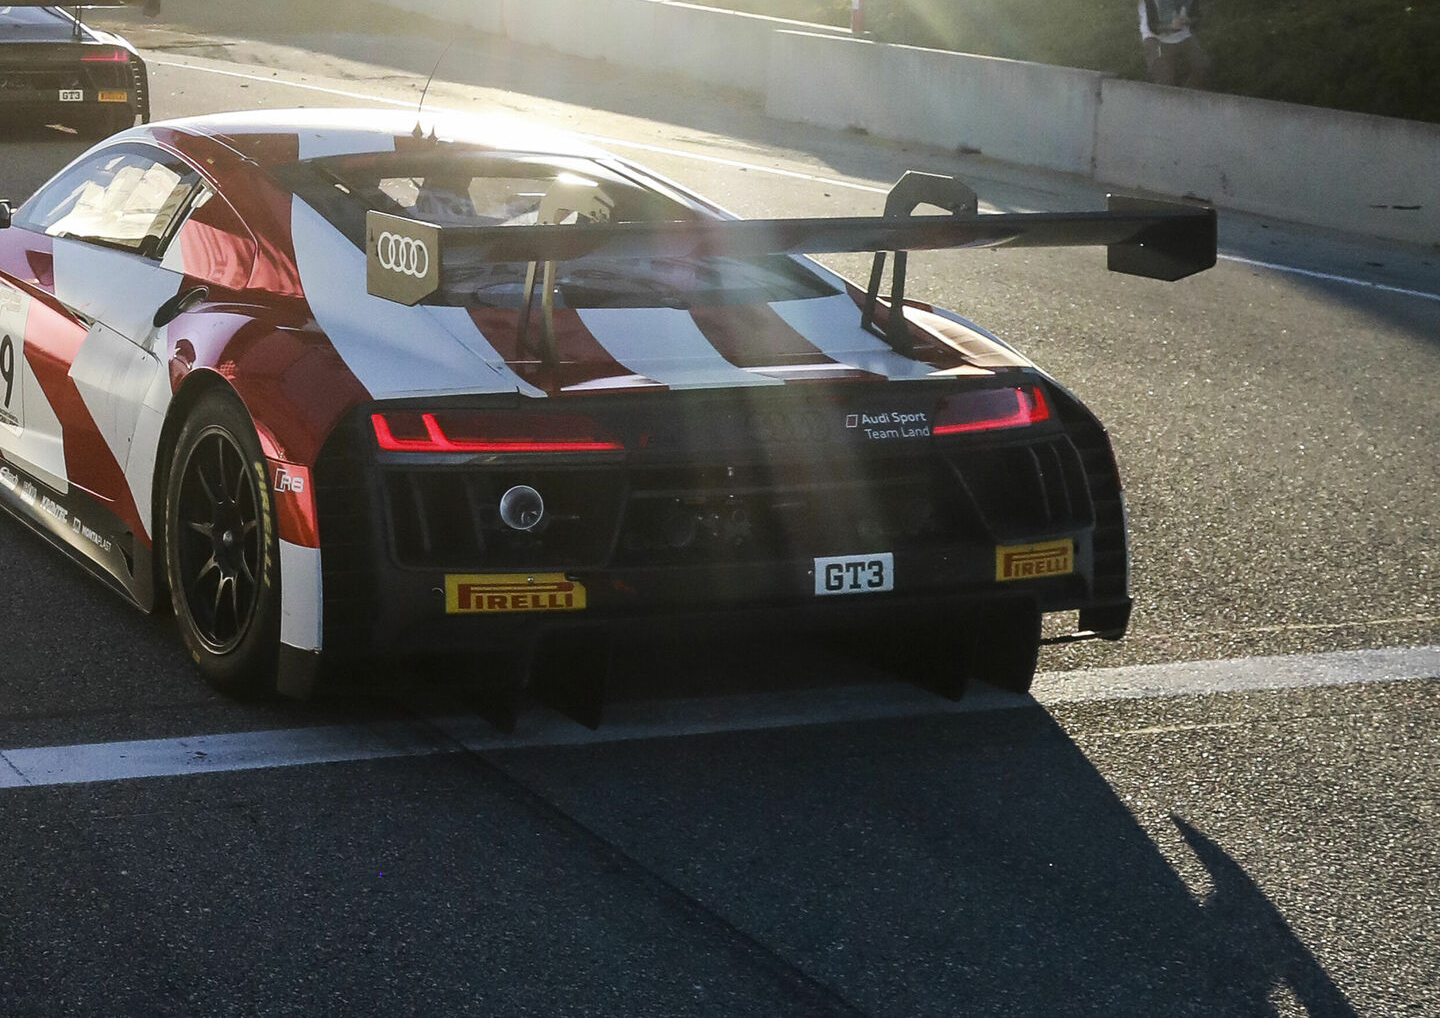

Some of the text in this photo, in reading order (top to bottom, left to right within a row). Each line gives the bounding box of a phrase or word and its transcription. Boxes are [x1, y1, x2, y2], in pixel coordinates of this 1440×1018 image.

[62, 92, 81, 100] GT3
[861, 412, 927, 425] Audi Sport
[864, 426, 930, 439] Team Land
[280, 475, 304, 493] R8
[1003, 546, 1069, 578] PIRELLI
[825, 560, 884, 591] GT3
[458, 582, 574, 610] PIRELLI
